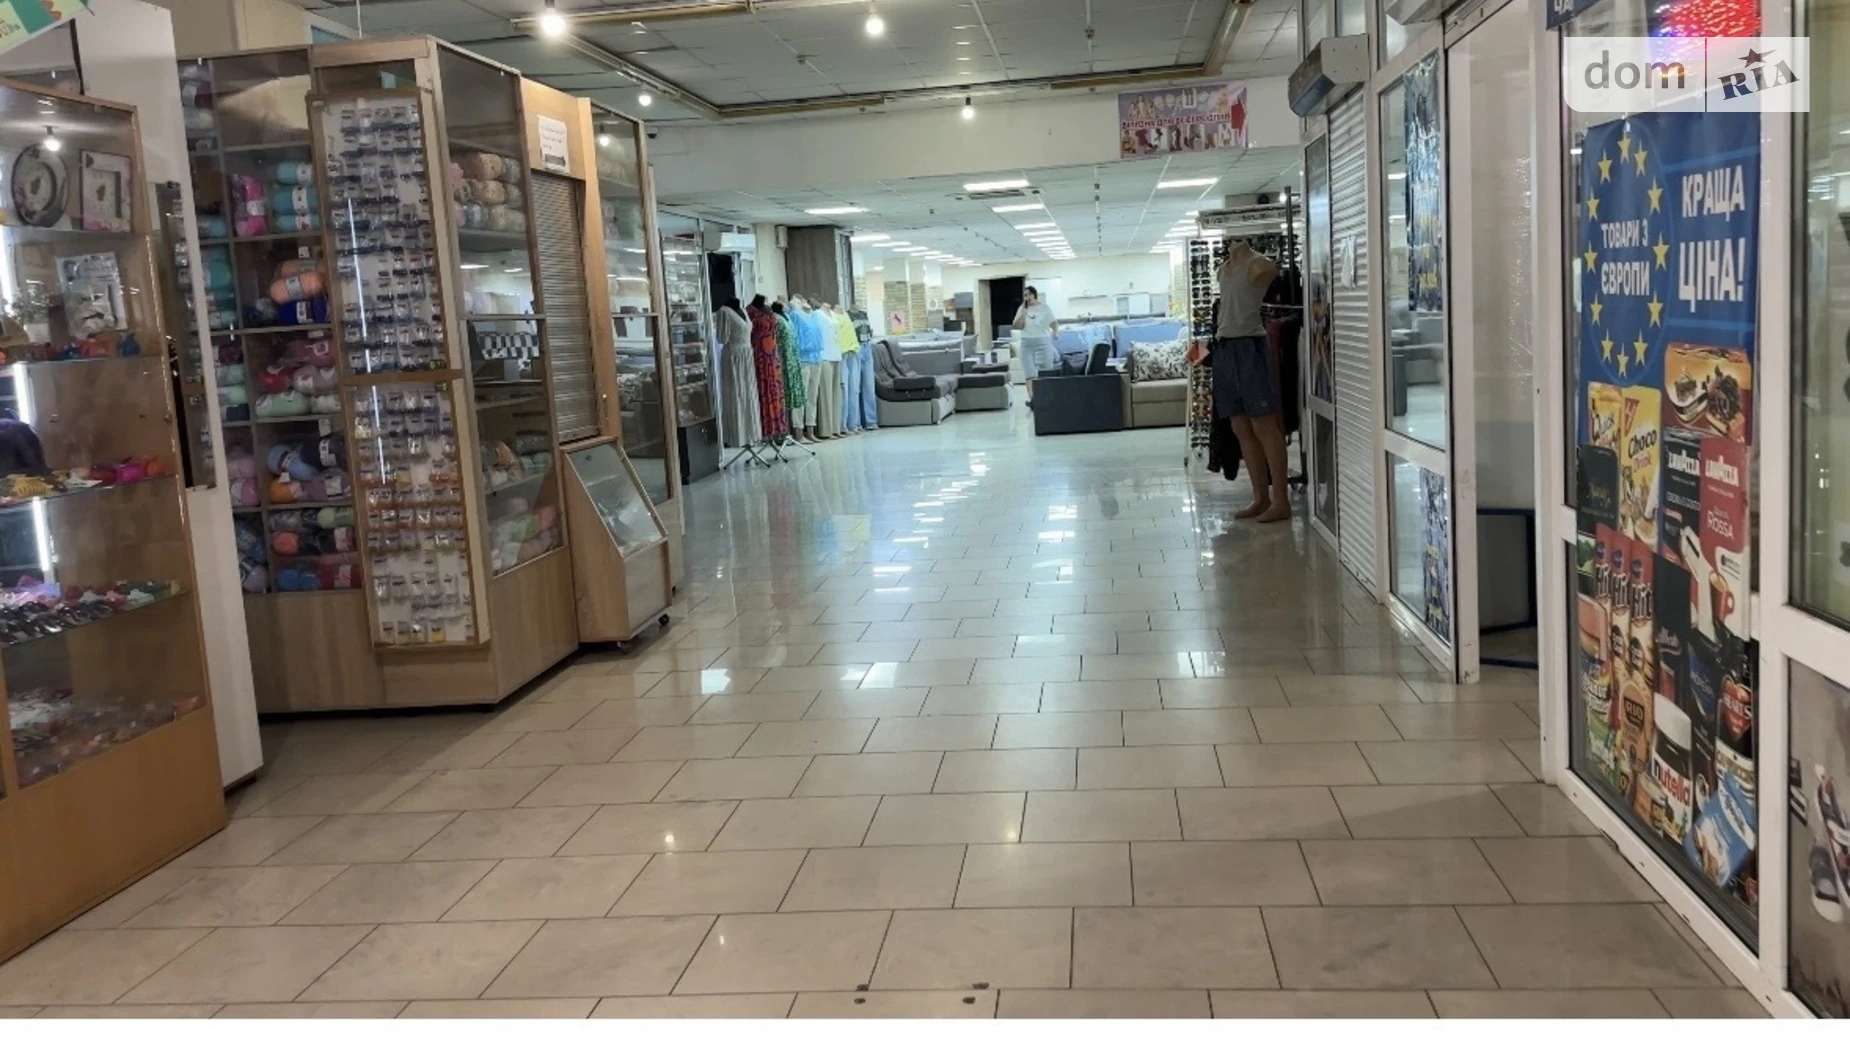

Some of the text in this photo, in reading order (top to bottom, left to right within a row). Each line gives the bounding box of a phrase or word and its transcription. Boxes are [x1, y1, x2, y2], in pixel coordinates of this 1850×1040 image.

[1682, 165, 1745, 221] КРАЩА
[1601, 221, 1639, 248] ТОВАРИ
[1601, 261, 1650, 296] ЄВРОПИ
[1678, 237, 1746, 313] ЦІНА!
[1628, 429, 1658, 459] Choco
[1706, 510, 1735, 540] ROSSA
[1652, 757, 1692, 808] nutella
